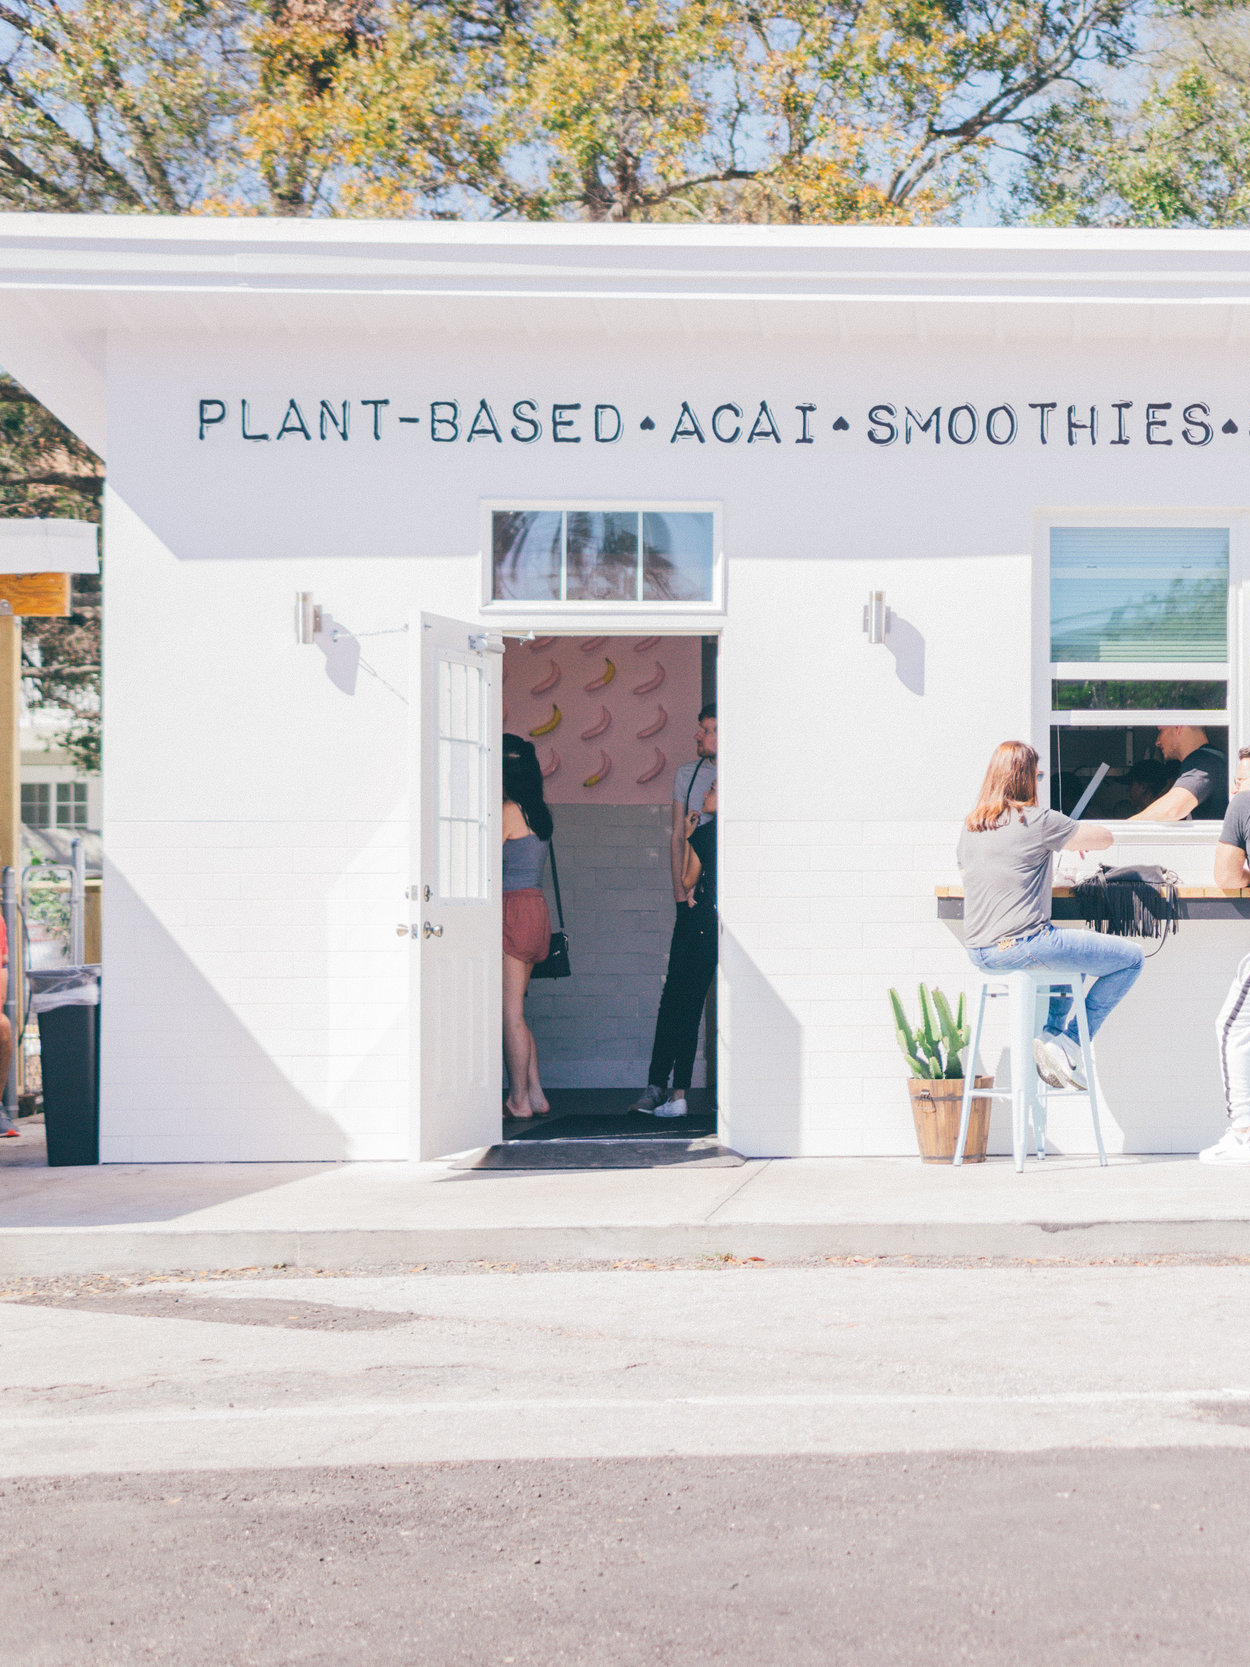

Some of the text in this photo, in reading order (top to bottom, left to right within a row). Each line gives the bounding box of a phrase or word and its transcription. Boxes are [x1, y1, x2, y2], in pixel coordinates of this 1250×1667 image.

[198, 399, 624, 444] PLANT-BASED
[670, 400, 817, 444] ACAI
[867, 400, 1214, 447] SMOOTHIES
